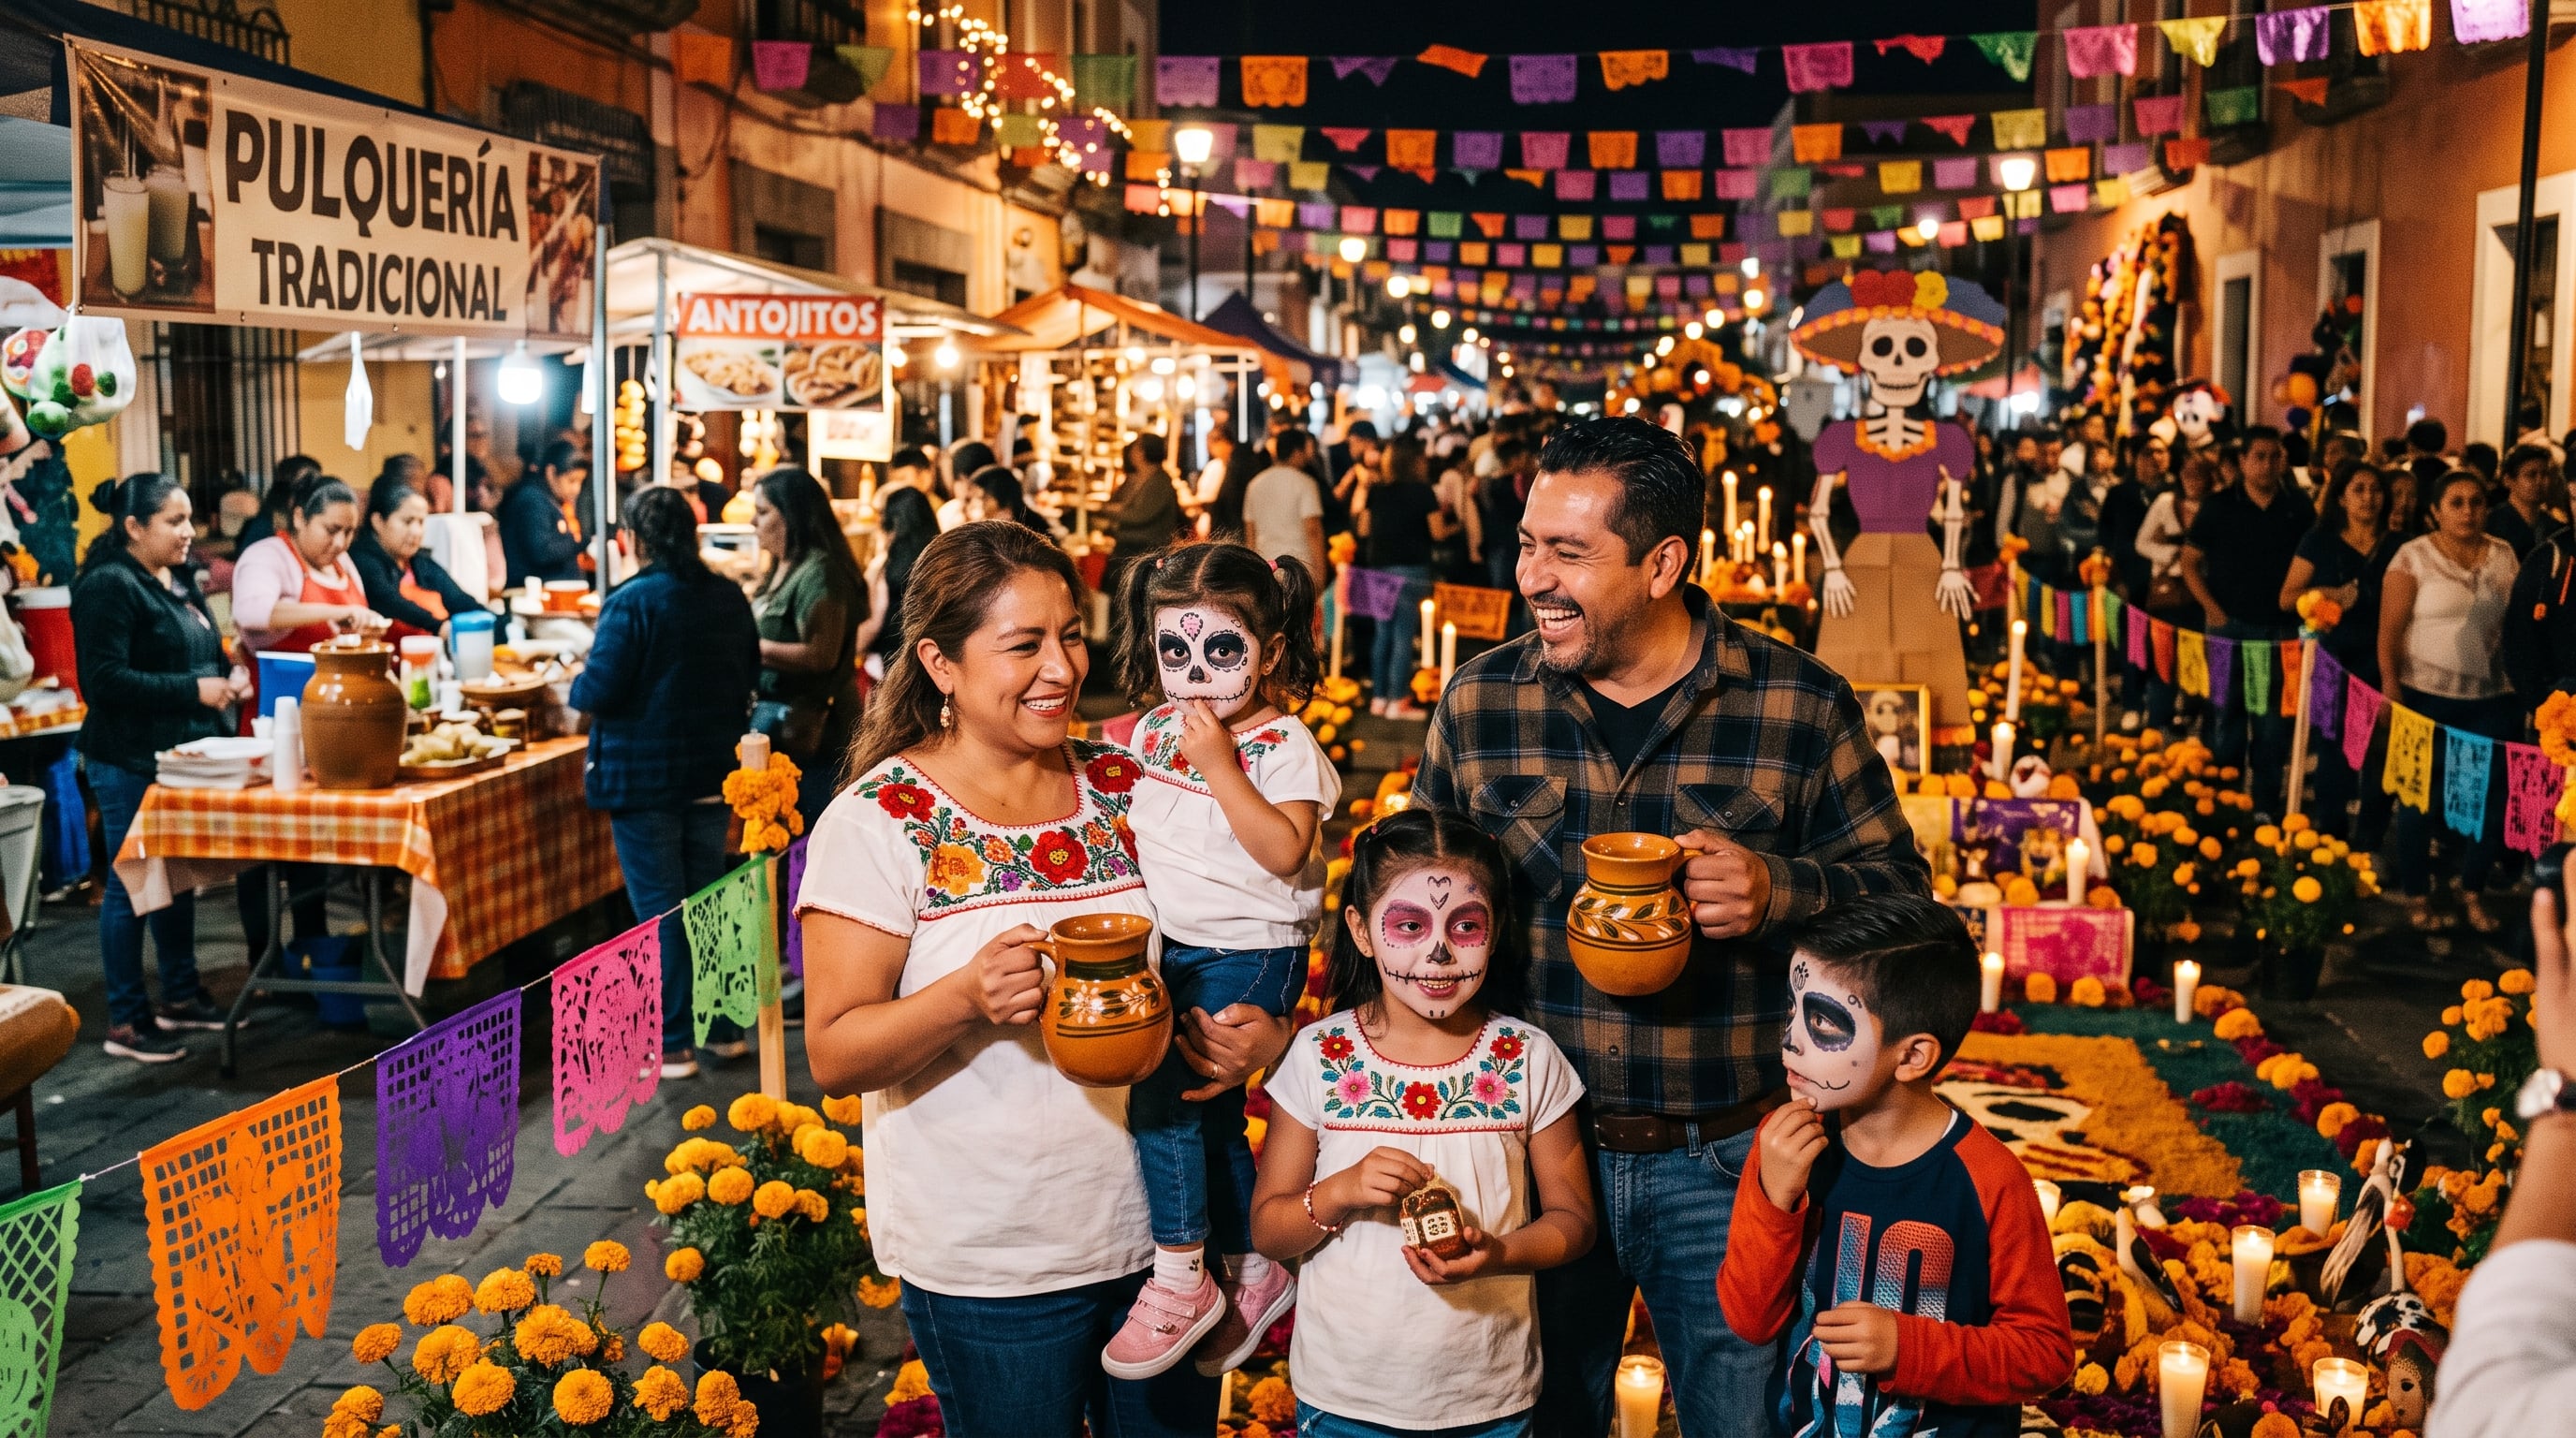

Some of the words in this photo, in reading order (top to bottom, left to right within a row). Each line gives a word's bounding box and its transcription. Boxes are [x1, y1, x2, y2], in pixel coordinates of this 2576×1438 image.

[226, 110, 519, 242] PULQUERÍA
[252, 238, 506, 321] TRADICIONAL
[688, 299, 876, 336] ANTOJITOS
